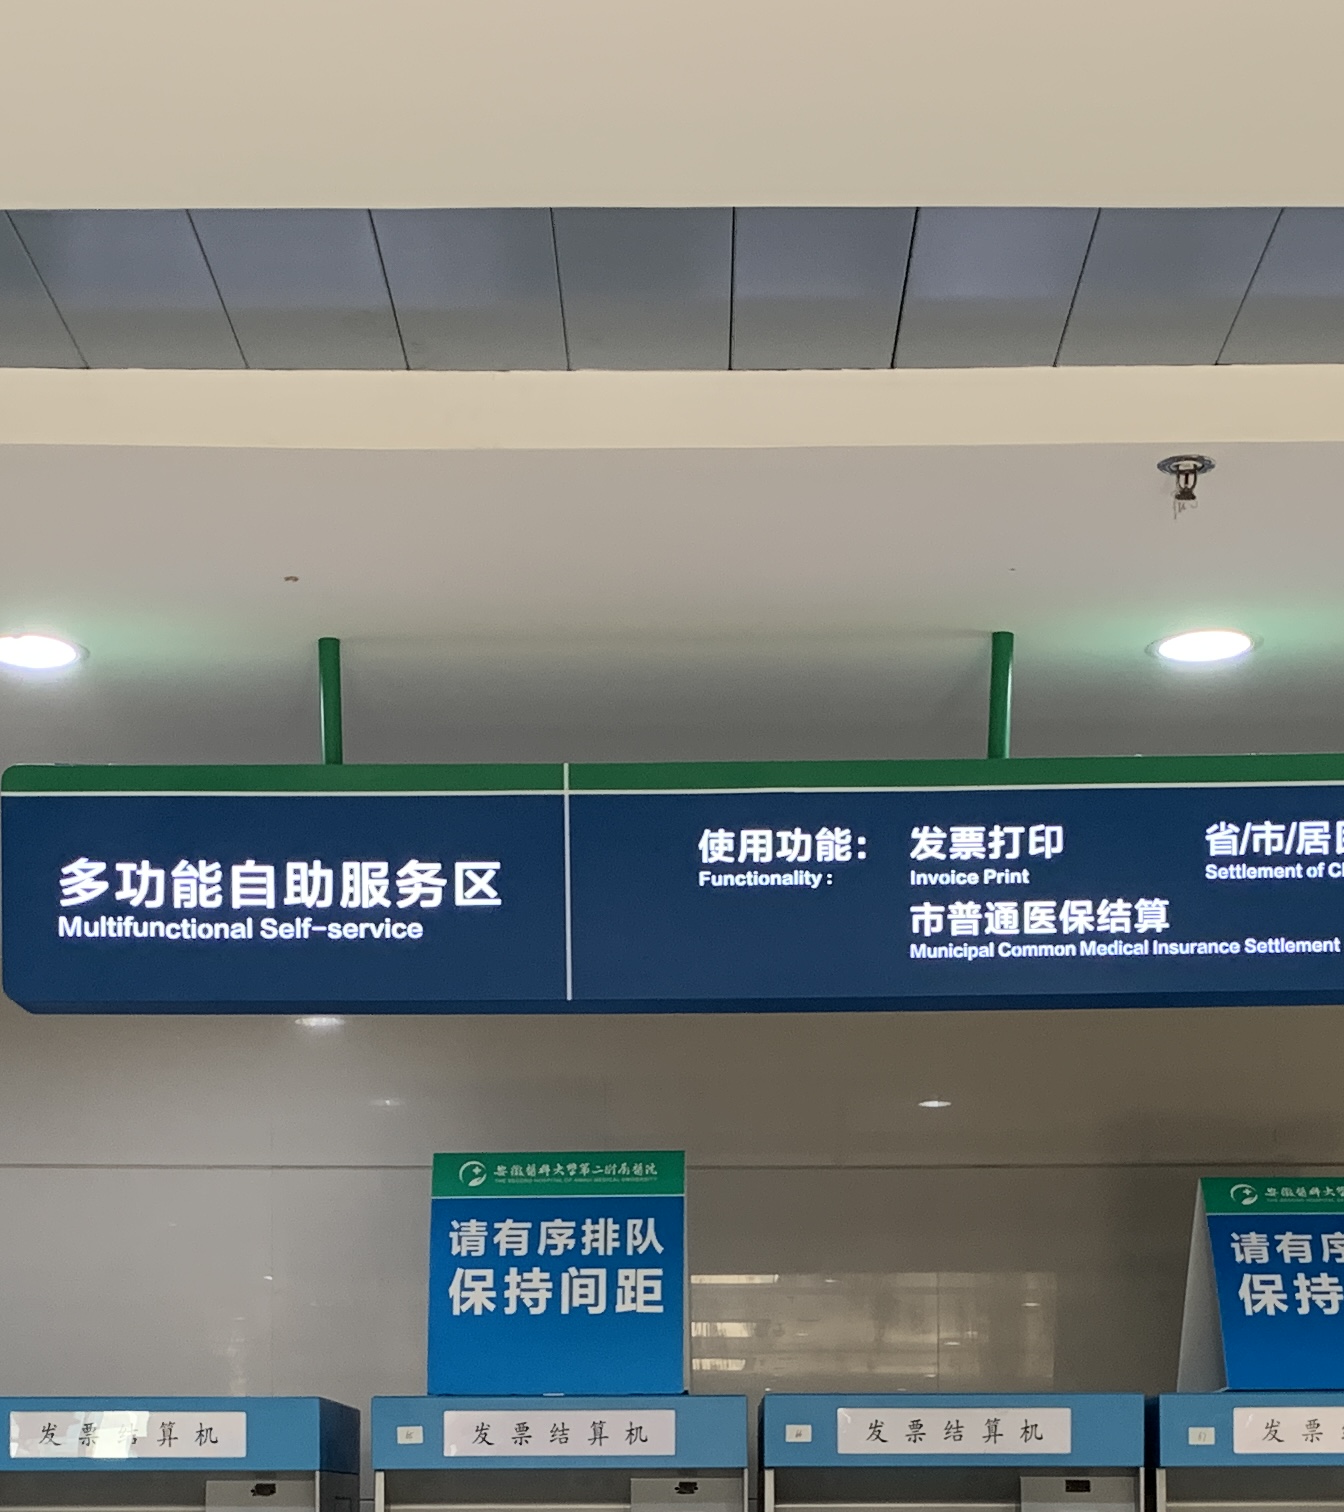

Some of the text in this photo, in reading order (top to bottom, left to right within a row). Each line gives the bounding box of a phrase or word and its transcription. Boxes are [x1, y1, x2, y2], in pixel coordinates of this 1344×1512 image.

[909, 823, 1064, 861] 发票打印
[59, 857, 502, 910] 多功能自助服务区
[910, 868, 1030, 886] Invoice Print
[1205, 863, 1304, 880] Settlement
[1305, 861, 1326, 879] of
[58, 915, 424, 940] Multifunctional Self-service
[909, 897, 1170, 937] 市普通医保结算
[909, 936, 1341, 962] Municipal Common Medical Insurance Settlement
[448, 1217, 665, 1257] 请有序排队
[448, 1266, 664, 1316] 保持间距
[472, 1420, 649, 1447] 发票结算机
[866, 1417, 1044, 1445] 发票结算机
